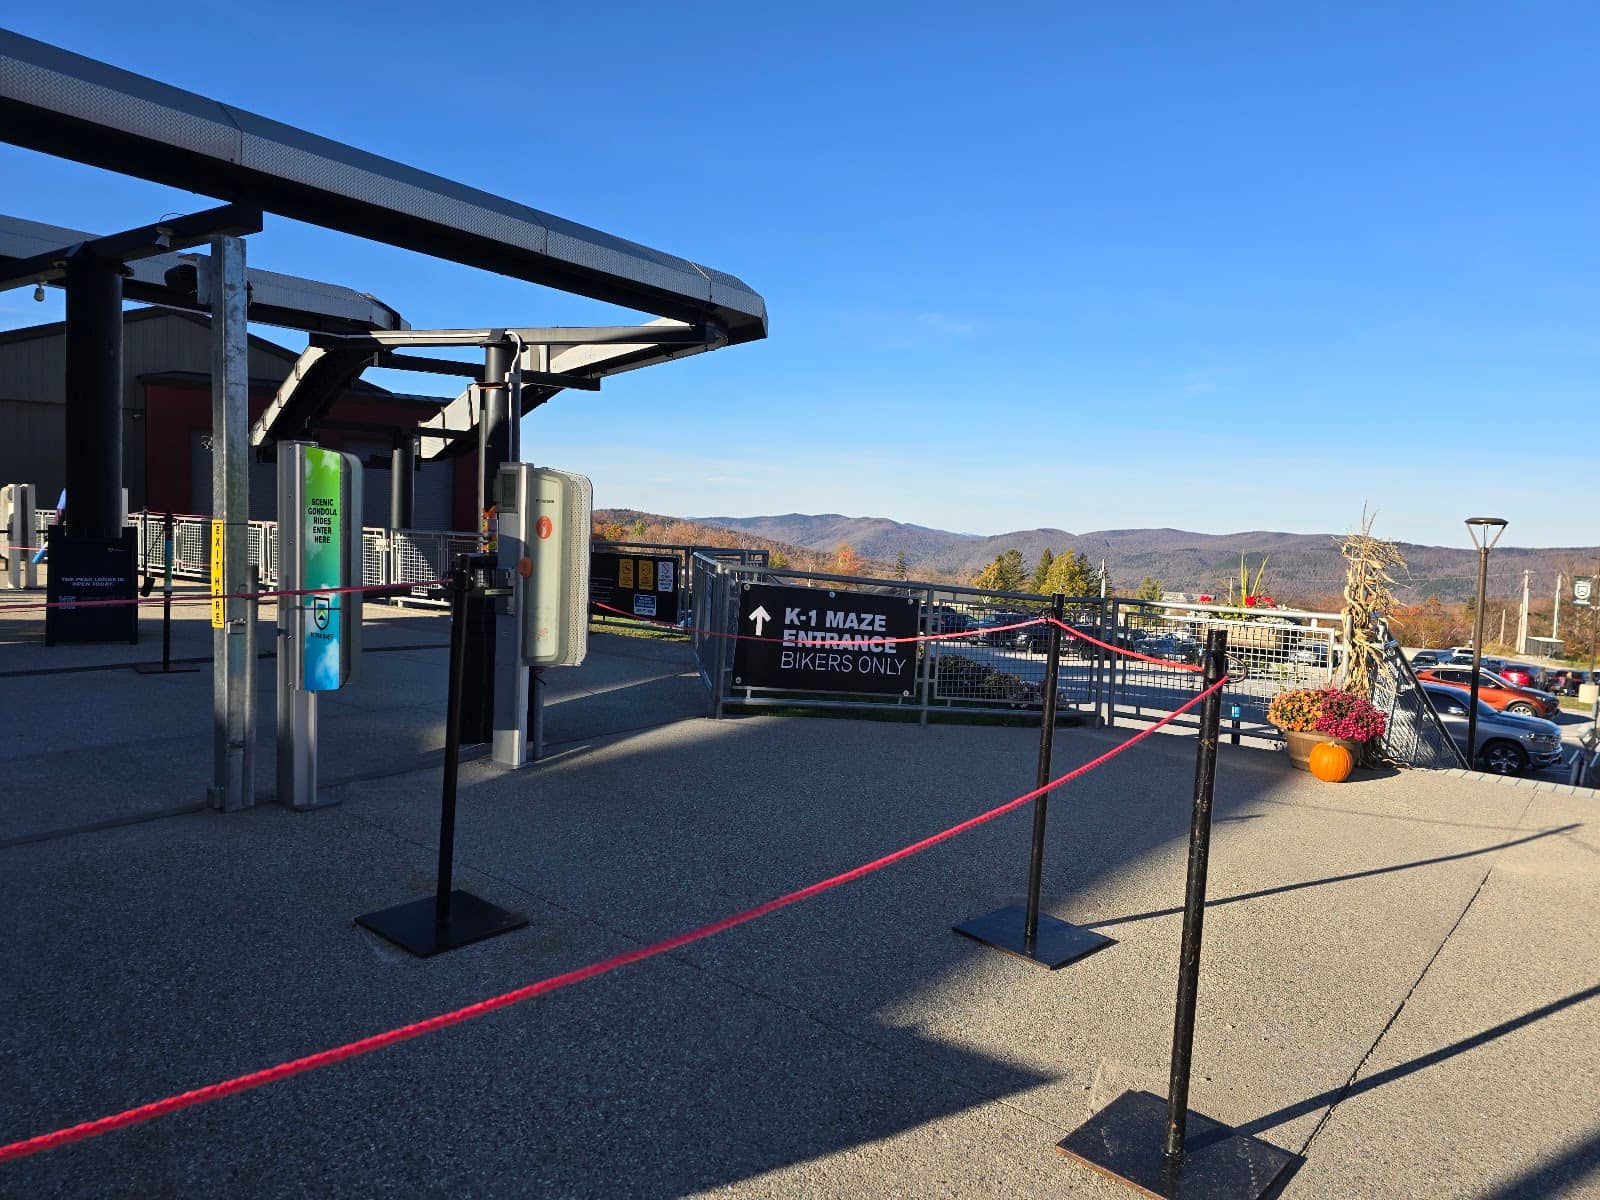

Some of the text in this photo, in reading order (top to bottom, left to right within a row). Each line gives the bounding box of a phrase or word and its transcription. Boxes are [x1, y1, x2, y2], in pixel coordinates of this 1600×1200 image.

[311, 498, 334, 506] SCENIC
[308, 507, 337, 516] GONDOLA
[313, 516, 331, 525] RIDES
[312, 526, 331, 535] ENTER
[314, 535, 331, 543] HERE
[784, 607, 887, 632] K-1 MAZE
[782, 629, 897, 654] ENTRANCE
[781, 651, 906, 676] BIKERS ONLY
